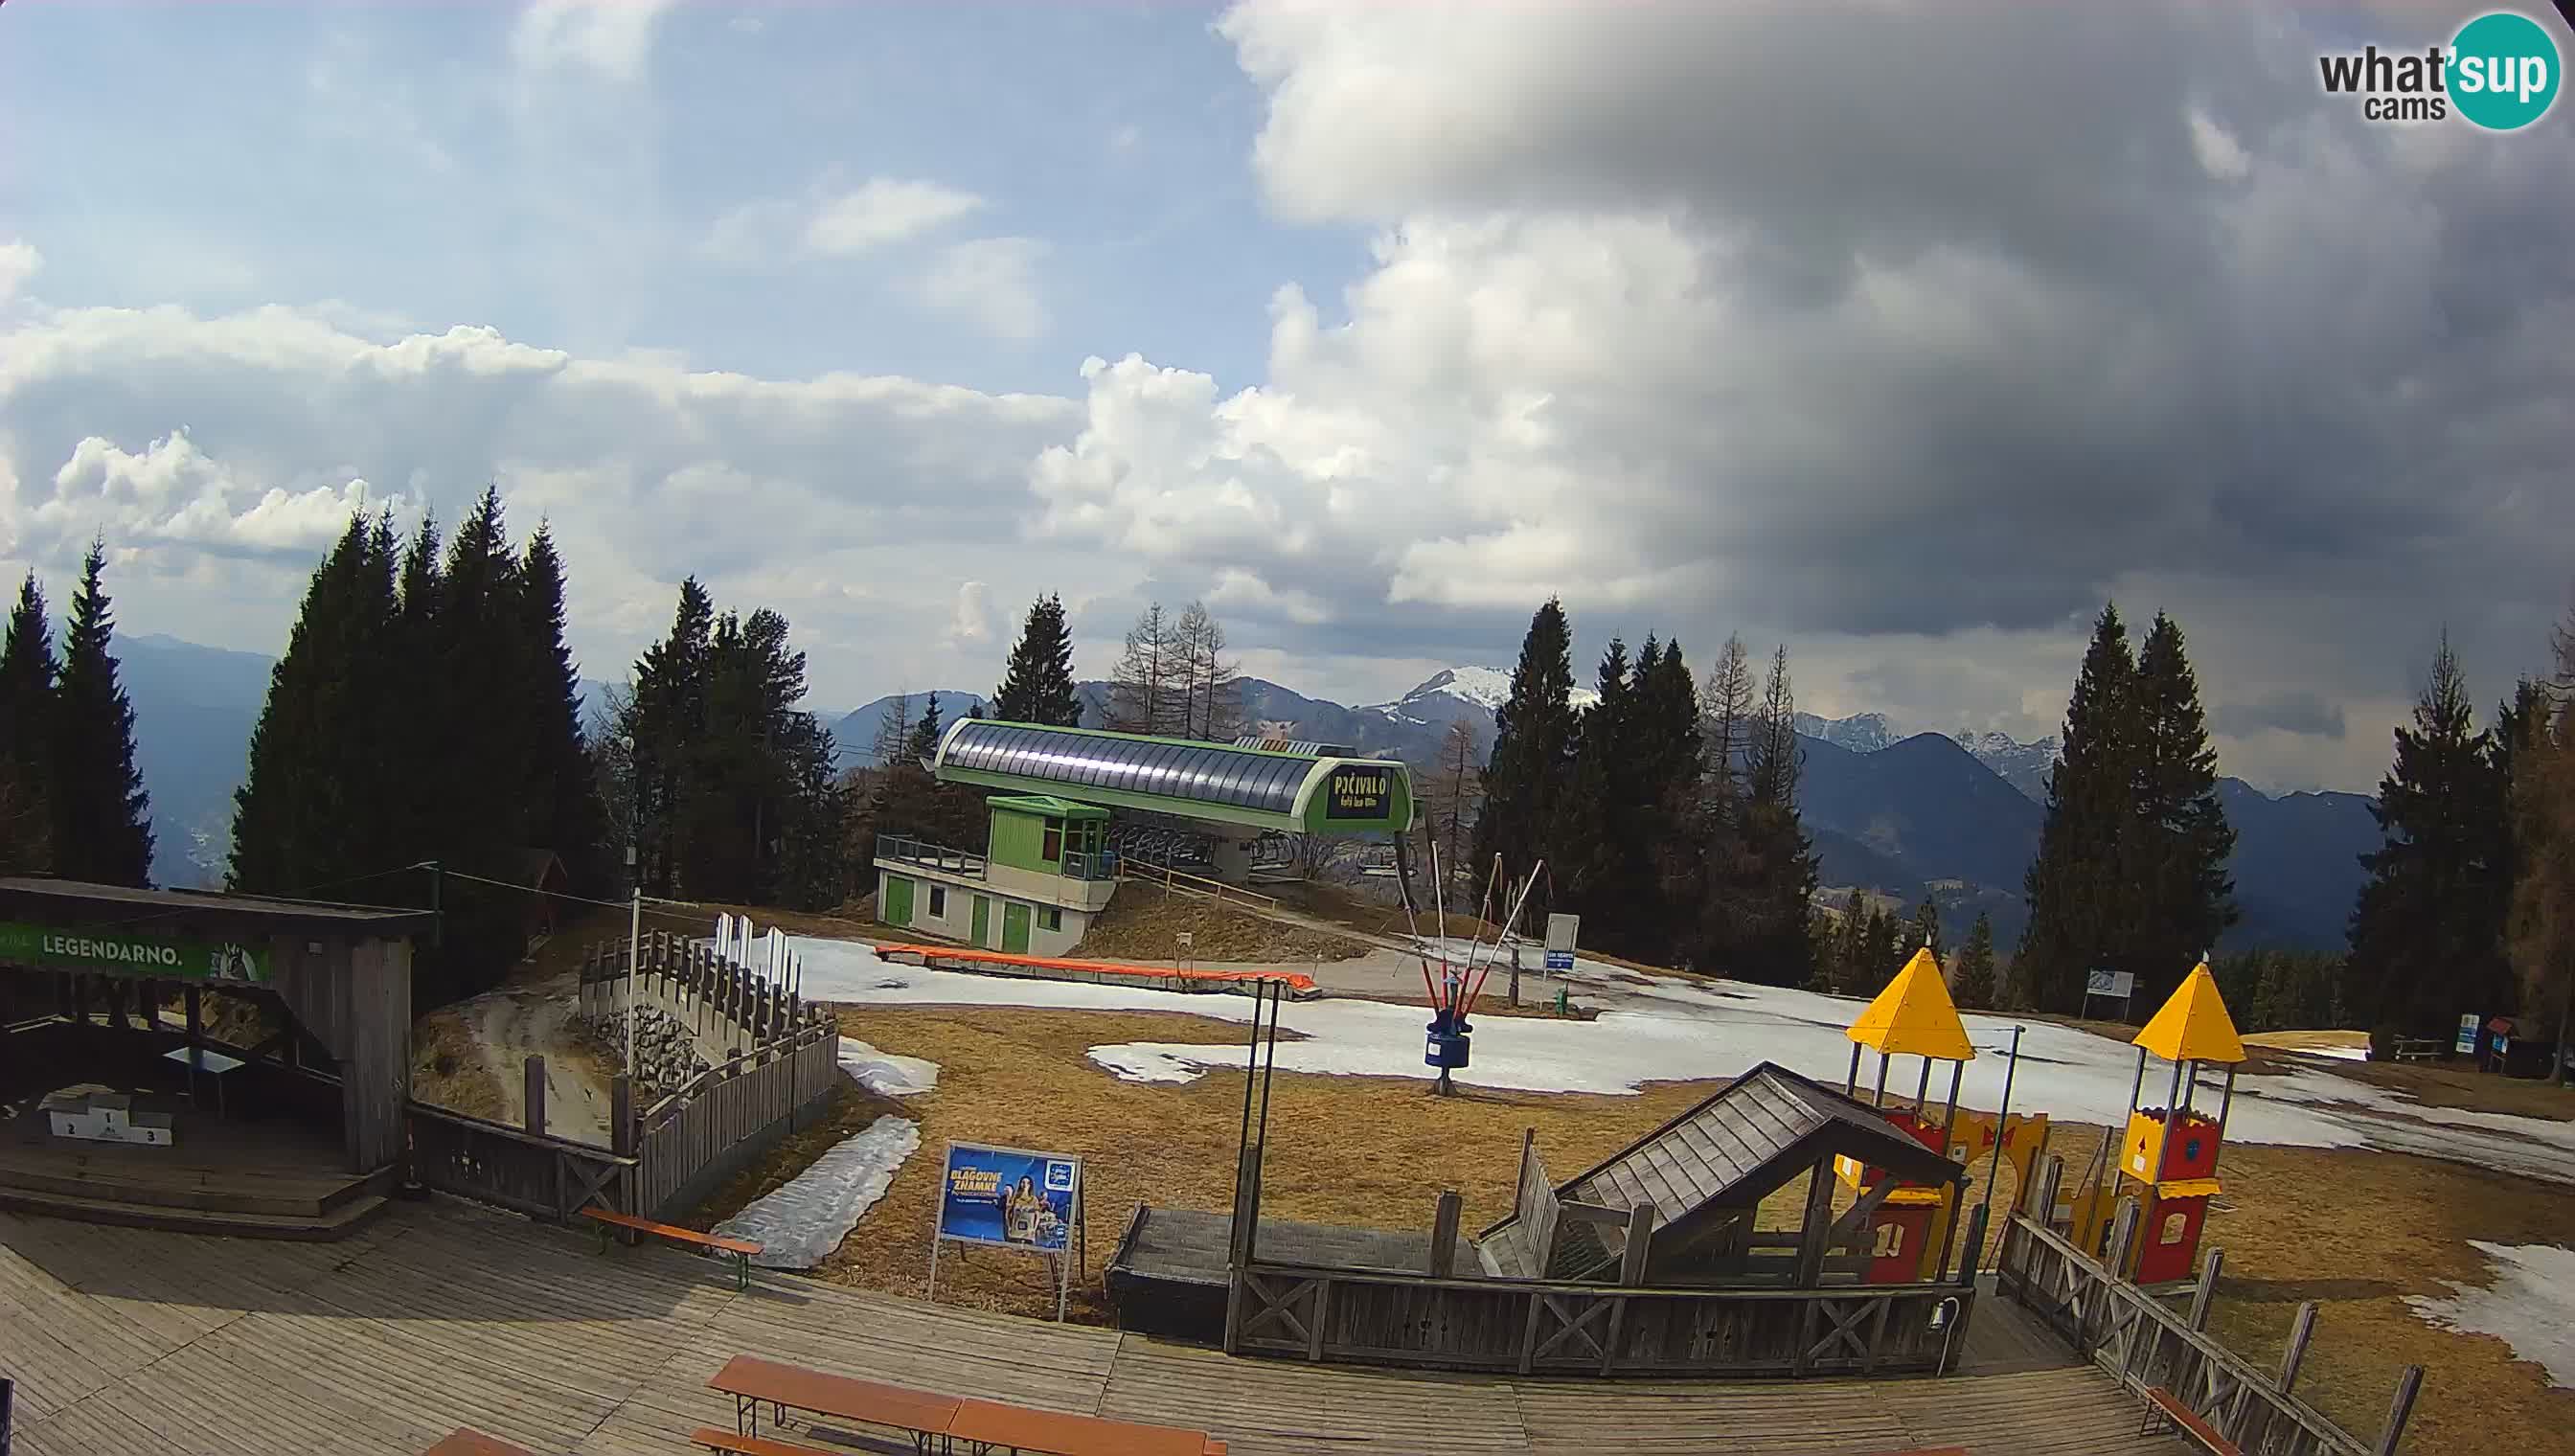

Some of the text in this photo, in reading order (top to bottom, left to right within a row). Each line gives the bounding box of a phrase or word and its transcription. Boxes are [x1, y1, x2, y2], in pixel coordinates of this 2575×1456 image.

[42, 934, 184, 967] LEGENDARNO.
[104, 1112, 112, 1124] 1
[67, 1124, 76, 1135] 2
[147, 1130, 156, 1143] 3
[950, 1169, 1003, 1183] BLAGOVNE
[953, 1180, 998, 1193] ZNAMKE
